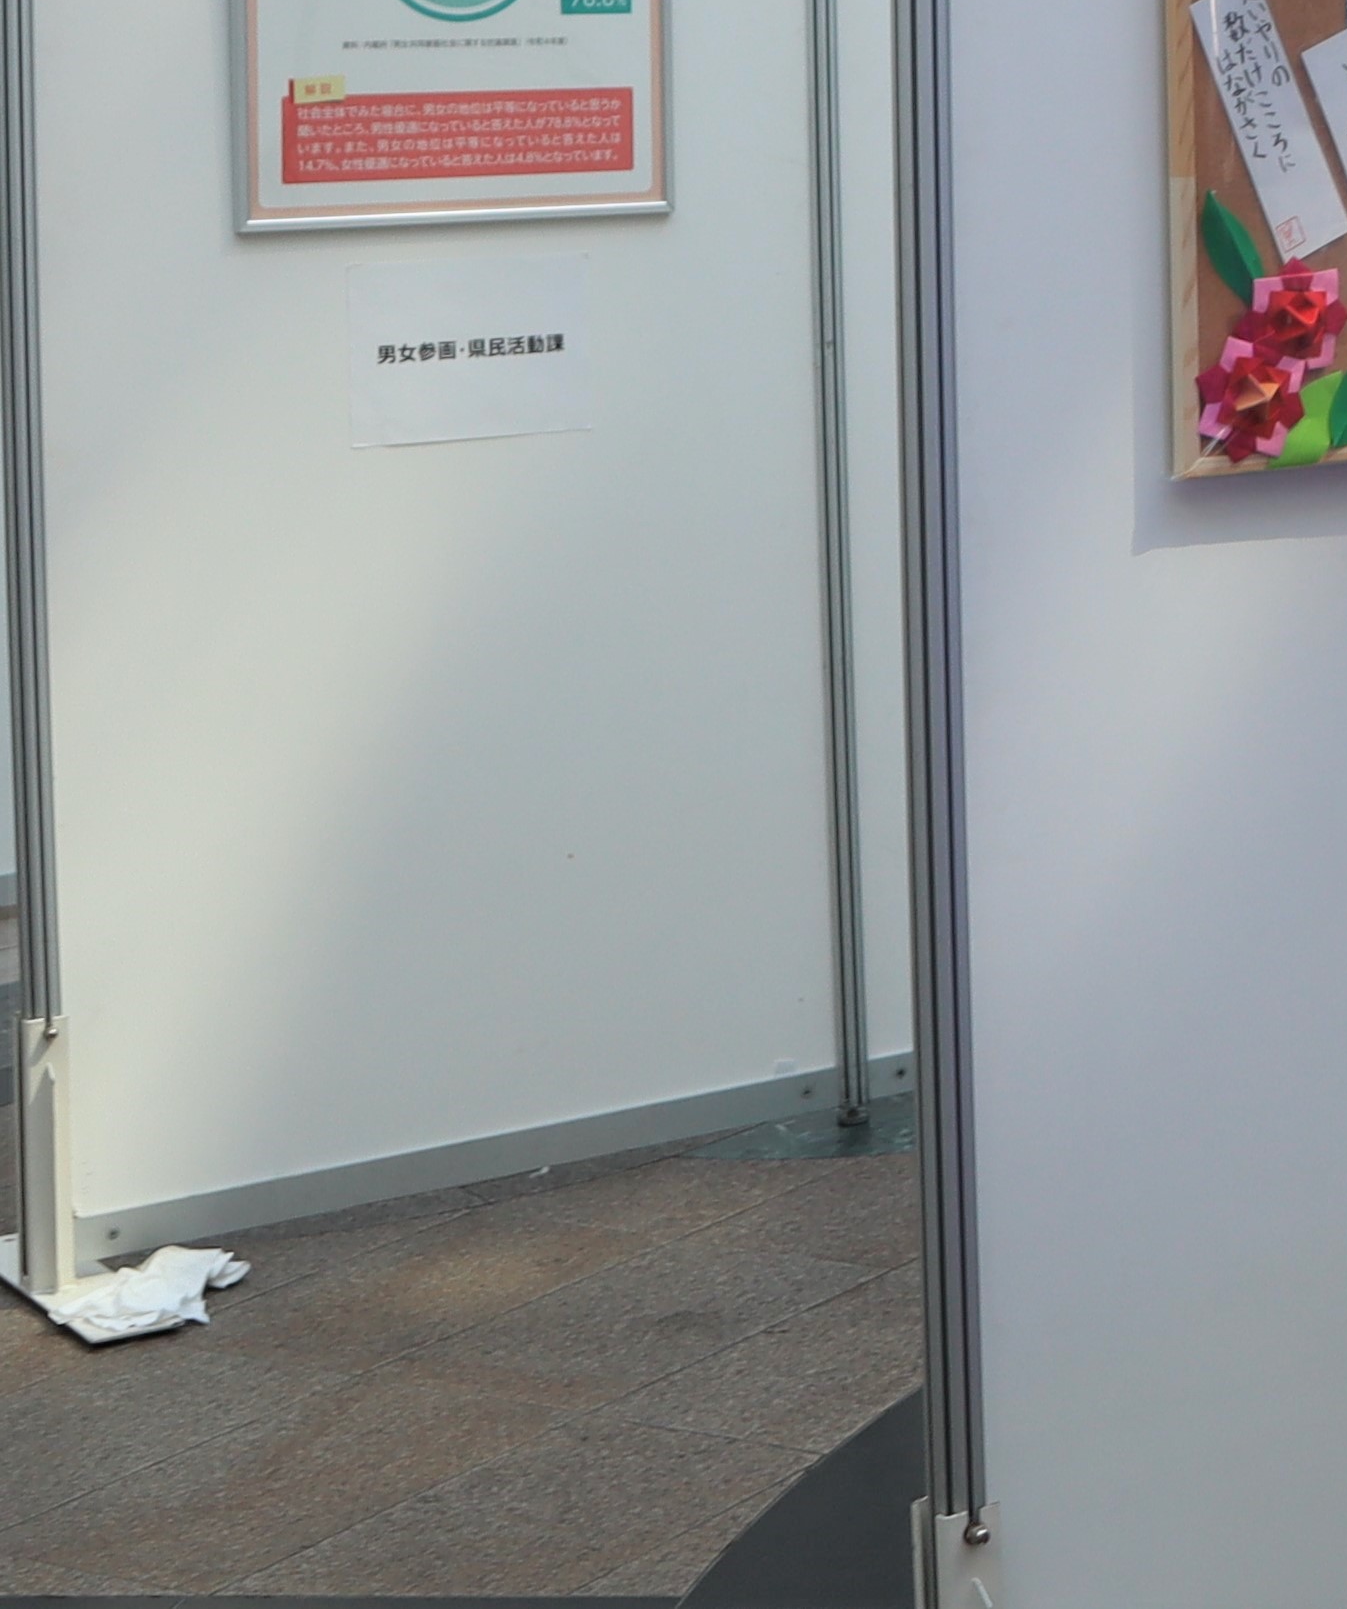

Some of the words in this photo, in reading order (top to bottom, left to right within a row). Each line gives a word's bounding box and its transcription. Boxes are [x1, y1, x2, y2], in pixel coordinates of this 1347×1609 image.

[1216, 48, 1267, 159] はながさく
[377, 333, 565, 365] 男女参画・県民活動課
